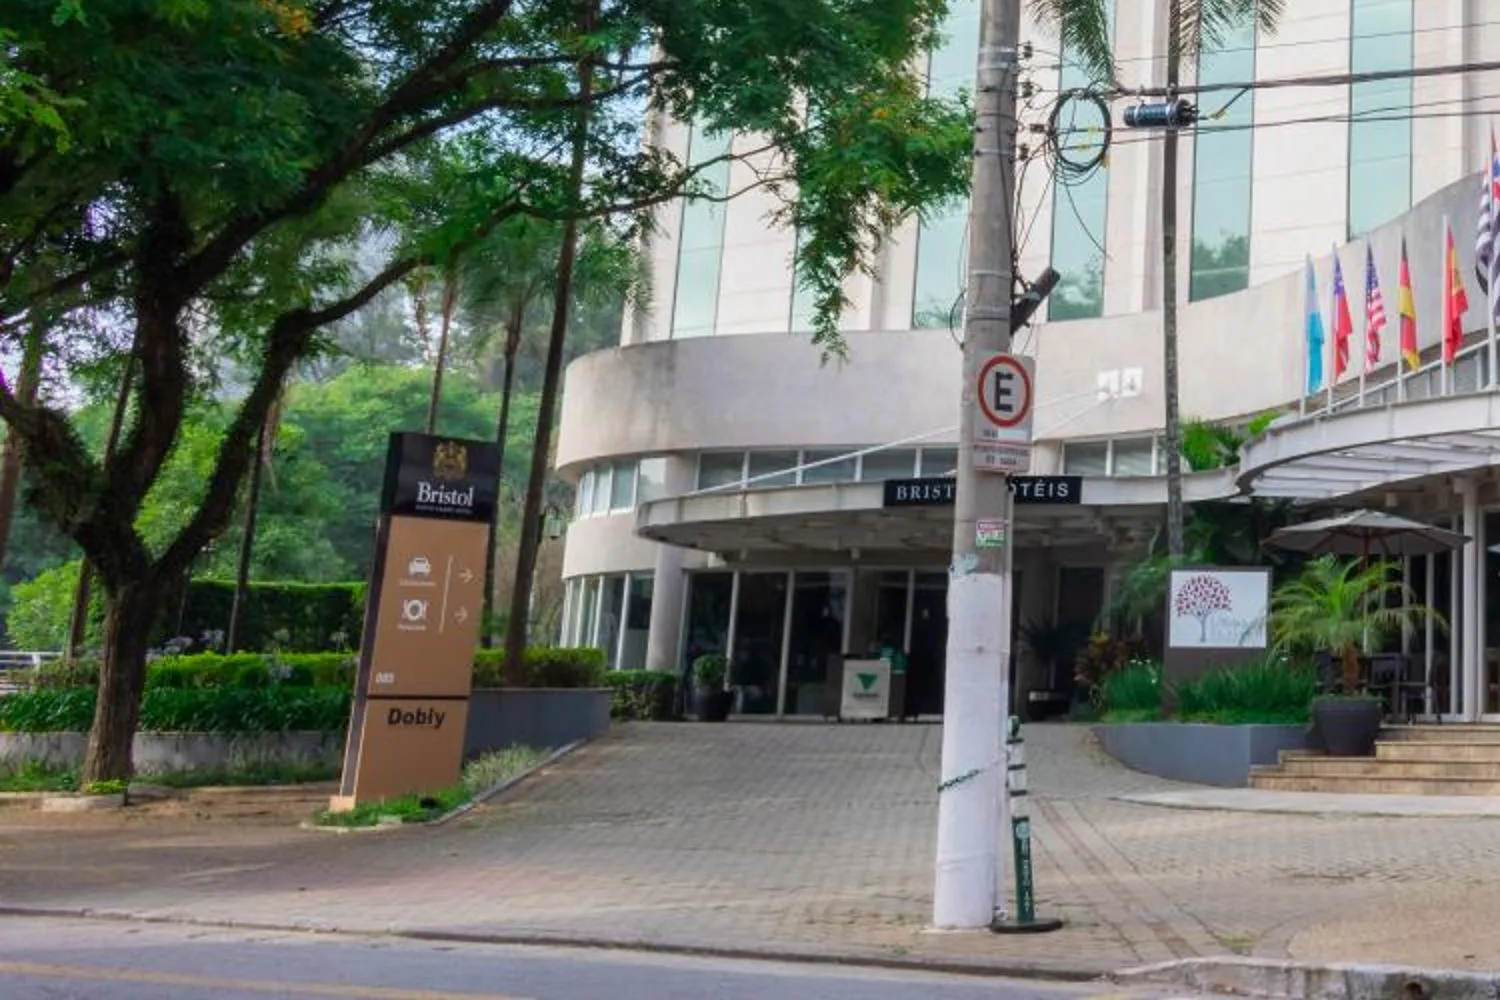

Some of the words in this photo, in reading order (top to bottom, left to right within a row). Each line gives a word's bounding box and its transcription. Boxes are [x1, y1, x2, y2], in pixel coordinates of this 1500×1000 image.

[994, 371, 1014, 413] E
[416, 481, 475, 507] Bristol
[896, 483, 956, 500] BRIST
